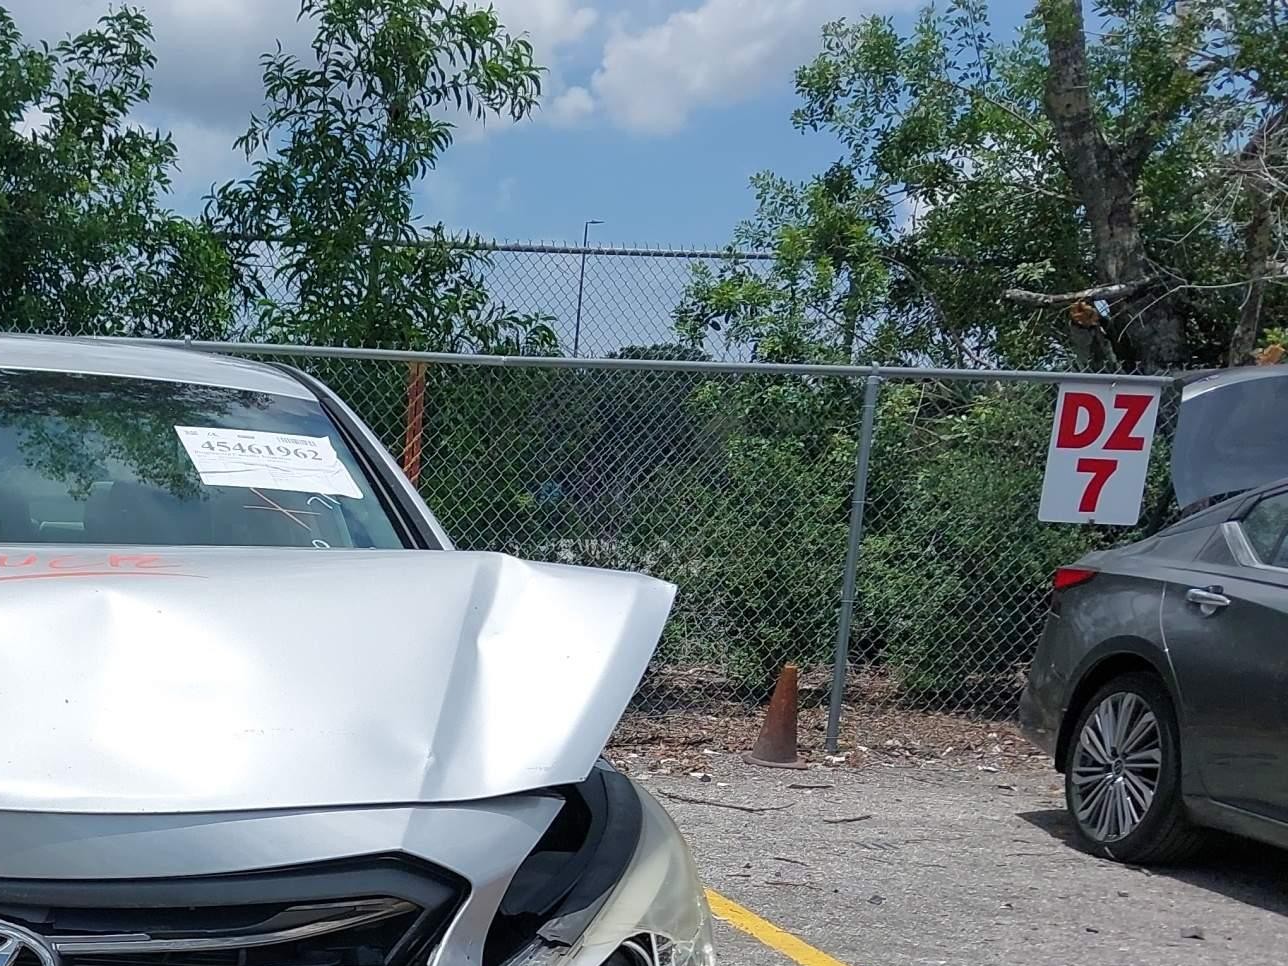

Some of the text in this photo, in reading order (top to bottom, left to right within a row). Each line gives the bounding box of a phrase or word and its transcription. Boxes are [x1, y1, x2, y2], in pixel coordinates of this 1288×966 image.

[1056, 391, 1154, 451] DZ
[200, 440, 323, 462] 45461962
[1076, 457, 1118, 513] 7
